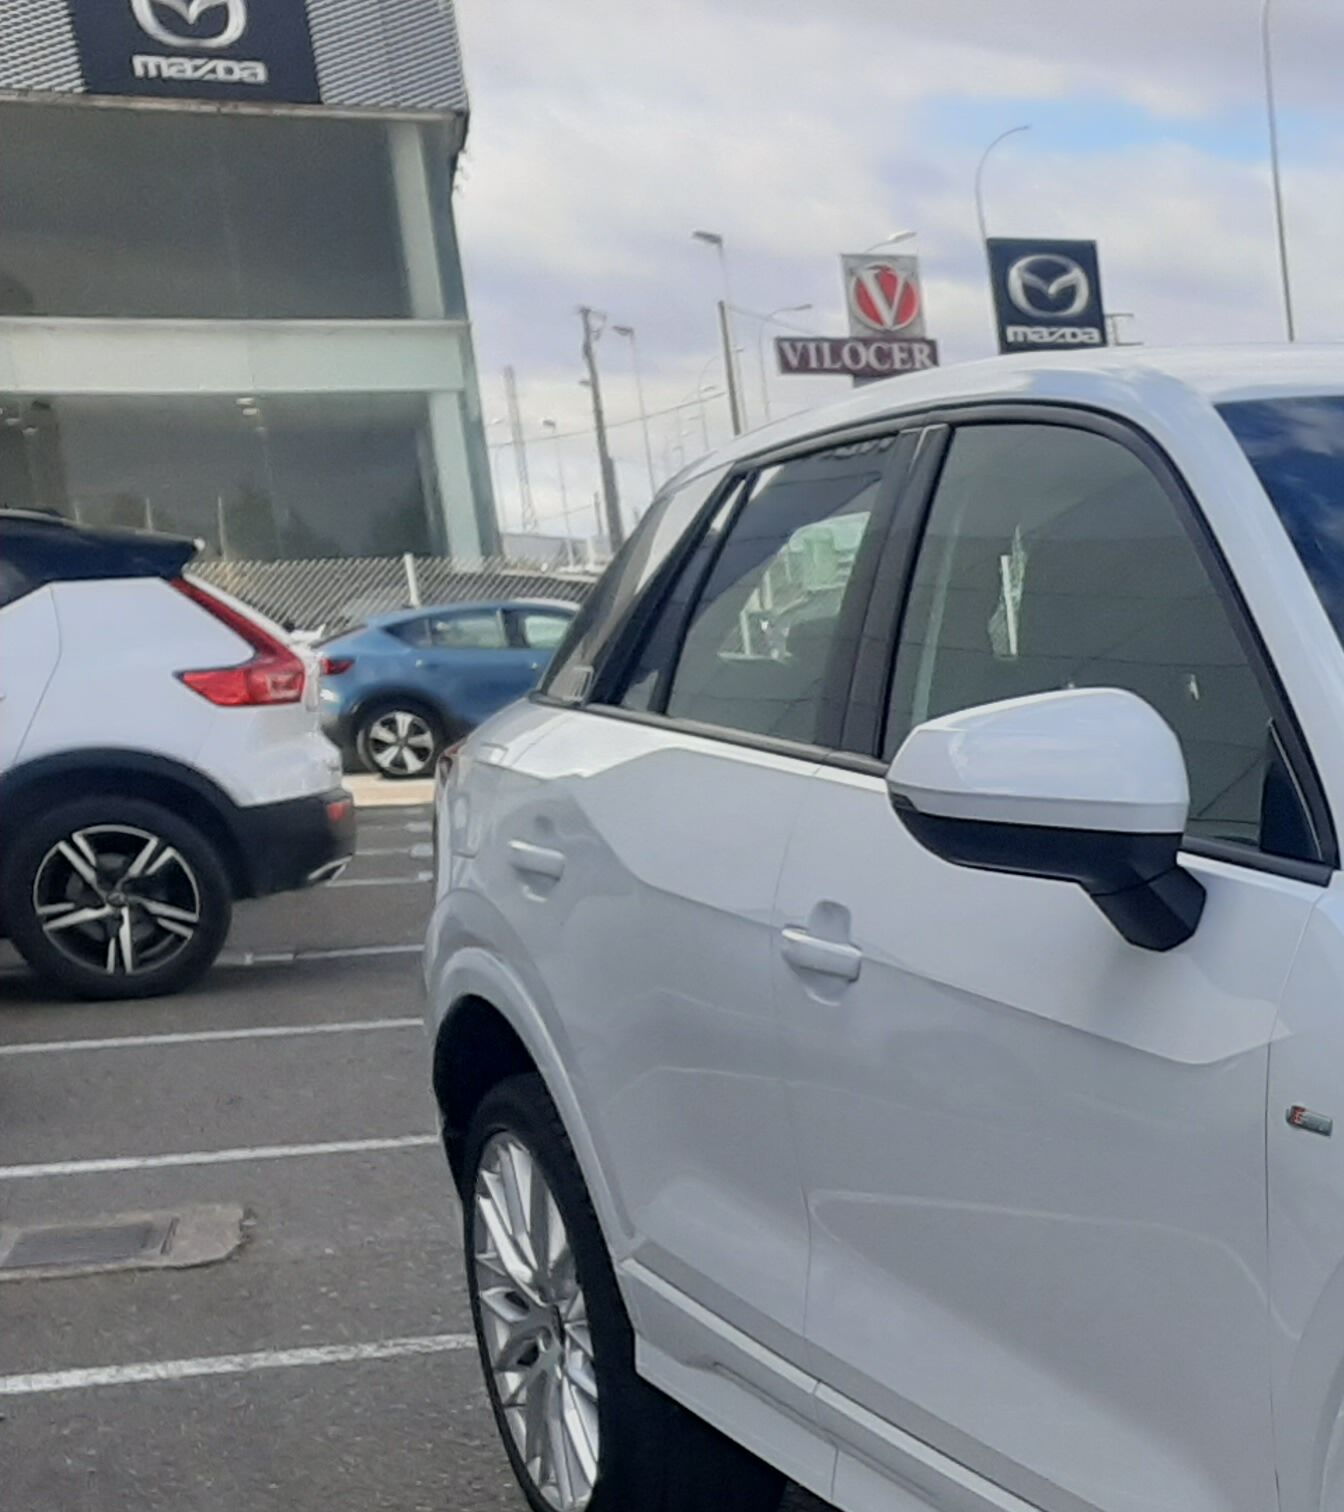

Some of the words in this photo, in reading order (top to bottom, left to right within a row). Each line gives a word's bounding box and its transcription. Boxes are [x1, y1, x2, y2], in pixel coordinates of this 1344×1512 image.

[132, 54, 268, 84] mazda
[1006, 325, 1100, 344] mazda
[779, 339, 933, 370] VILOCER
